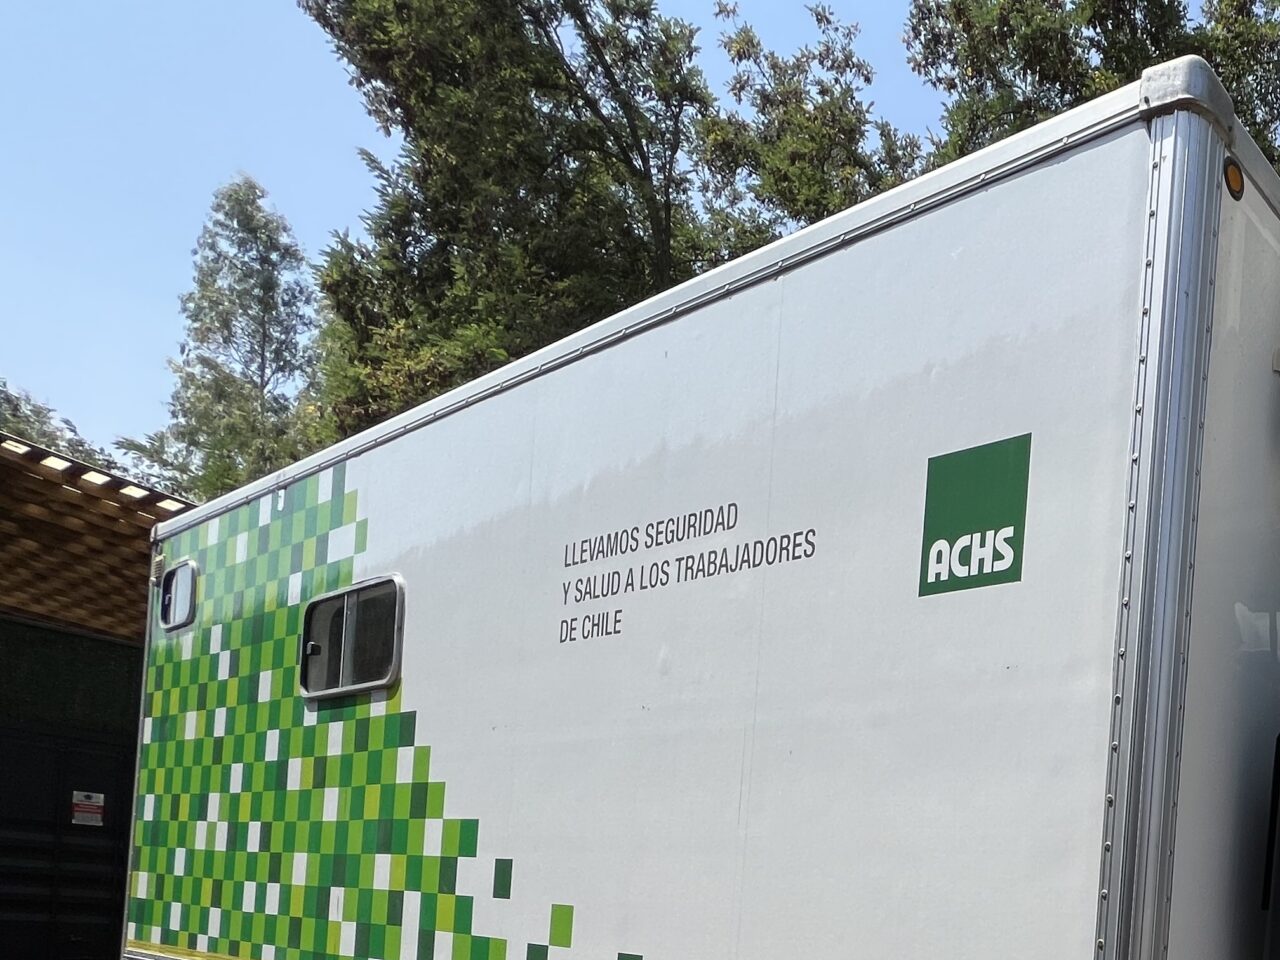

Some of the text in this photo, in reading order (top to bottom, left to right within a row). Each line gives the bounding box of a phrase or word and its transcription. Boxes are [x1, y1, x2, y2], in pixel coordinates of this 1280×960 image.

[563, 502, 738, 568] LLEVAMOS SEGURIDAD
[926, 525, 1015, 584] ACHS
[562, 528, 816, 605] Y SALUD A LOS TRABAJADORES
[559, 609, 623, 643] DE CHILE
